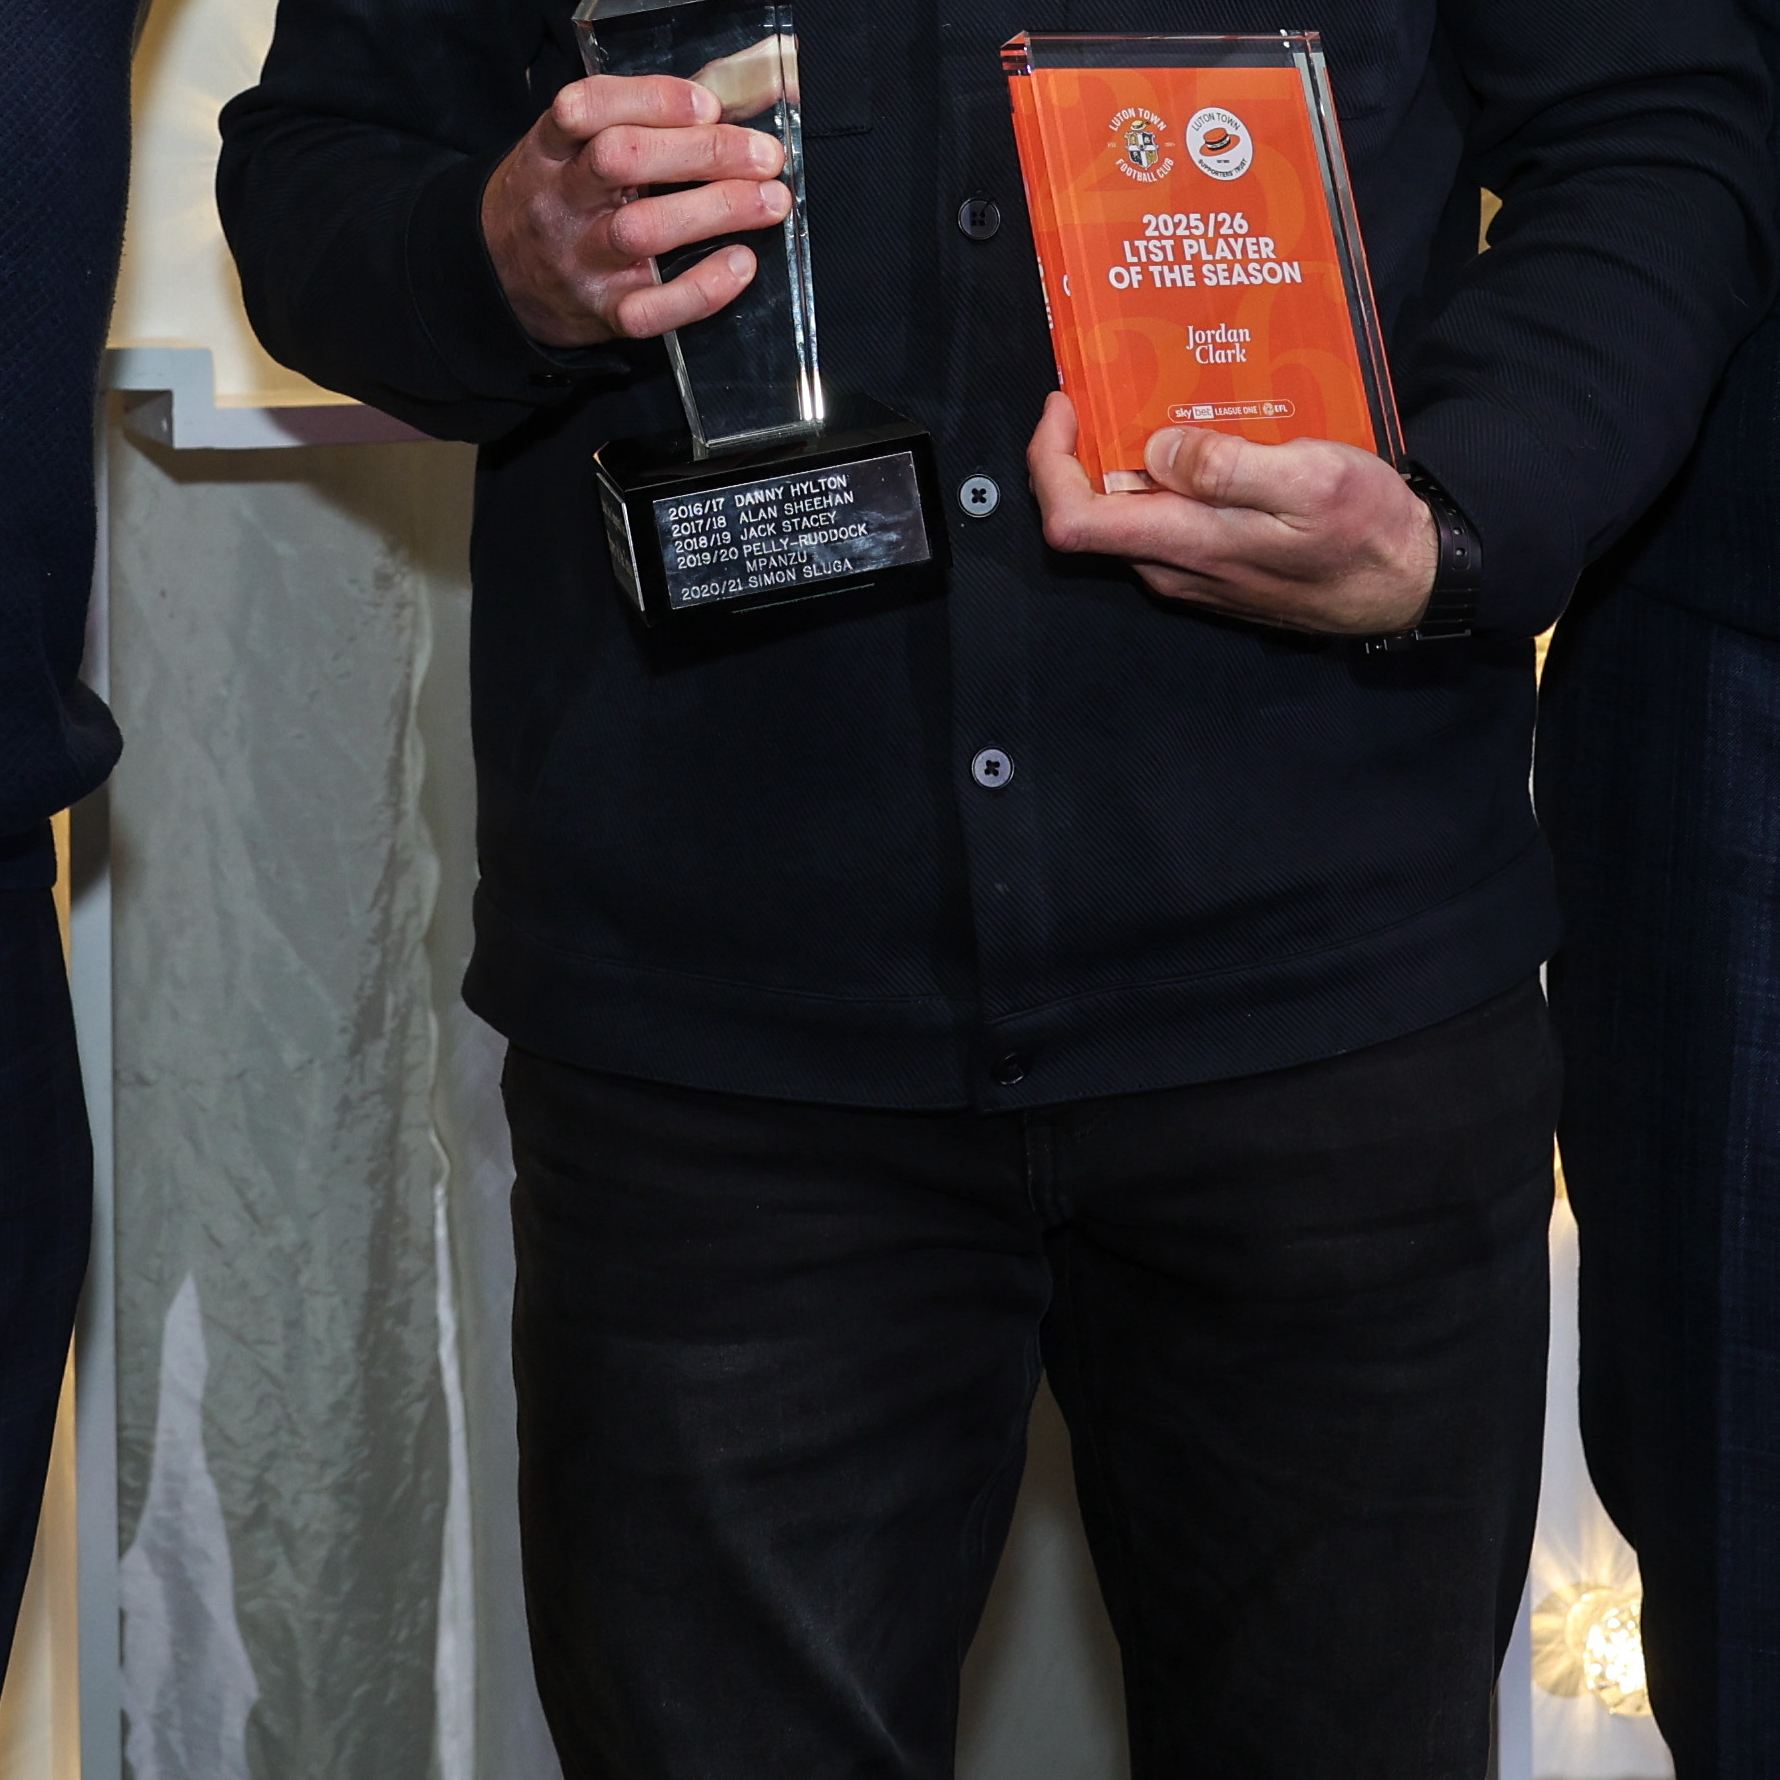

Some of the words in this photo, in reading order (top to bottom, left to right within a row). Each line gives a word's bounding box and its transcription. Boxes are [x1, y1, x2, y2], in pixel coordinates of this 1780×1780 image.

[1108, 107, 1136, 132] LUTON
[1137, 107, 1167, 132] TOWN
[1191, 112, 1216, 132] LUTON
[1216, 112, 1241, 131] TOWN
[1115, 158, 1158, 183] FOOTBALL
[1156, 157, 1175, 180] CLUB
[1142, 212, 1249, 238] 2025/26
[1123, 239, 1175, 263] LTST
[1182, 236, 1277, 261] PLAYER
[1108, 266, 1143, 289] OF
[1149, 264, 1196, 288] THE
[1201, 261, 1303, 286] SEASON
[1186, 323, 1251, 350] Jordan
[1195, 342, 1247, 364] Clark
[1175, 408, 1191, 419] sky
[1194, 406, 1212, 417] bet
[1214, 406, 1243, 416] LEAGUE
[1243, 405, 1258, 415] ONE
[668, 498, 725, 520] 2016/17
[734, 486, 784, 507] DANNY
[790, 474, 848, 496] HYLTON
[671, 516, 727, 537] 2017/18
[739, 505, 778, 524] ALAN
[783, 491, 855, 515] SHEEHAN
[674, 532, 731, 553] 2018/19
[740, 523, 777, 541] JACK
[782, 511, 837, 532] STACEY
[677, 547, 739, 570] 2019/20
[743, 523, 869, 557] PELLY-RUDDOCK
[745, 551, 808, 573] MPANZU
[682, 579, 743, 601] 2020/21
[748, 568, 797, 588] SIMON
[802, 558, 854, 578] SLUGA
